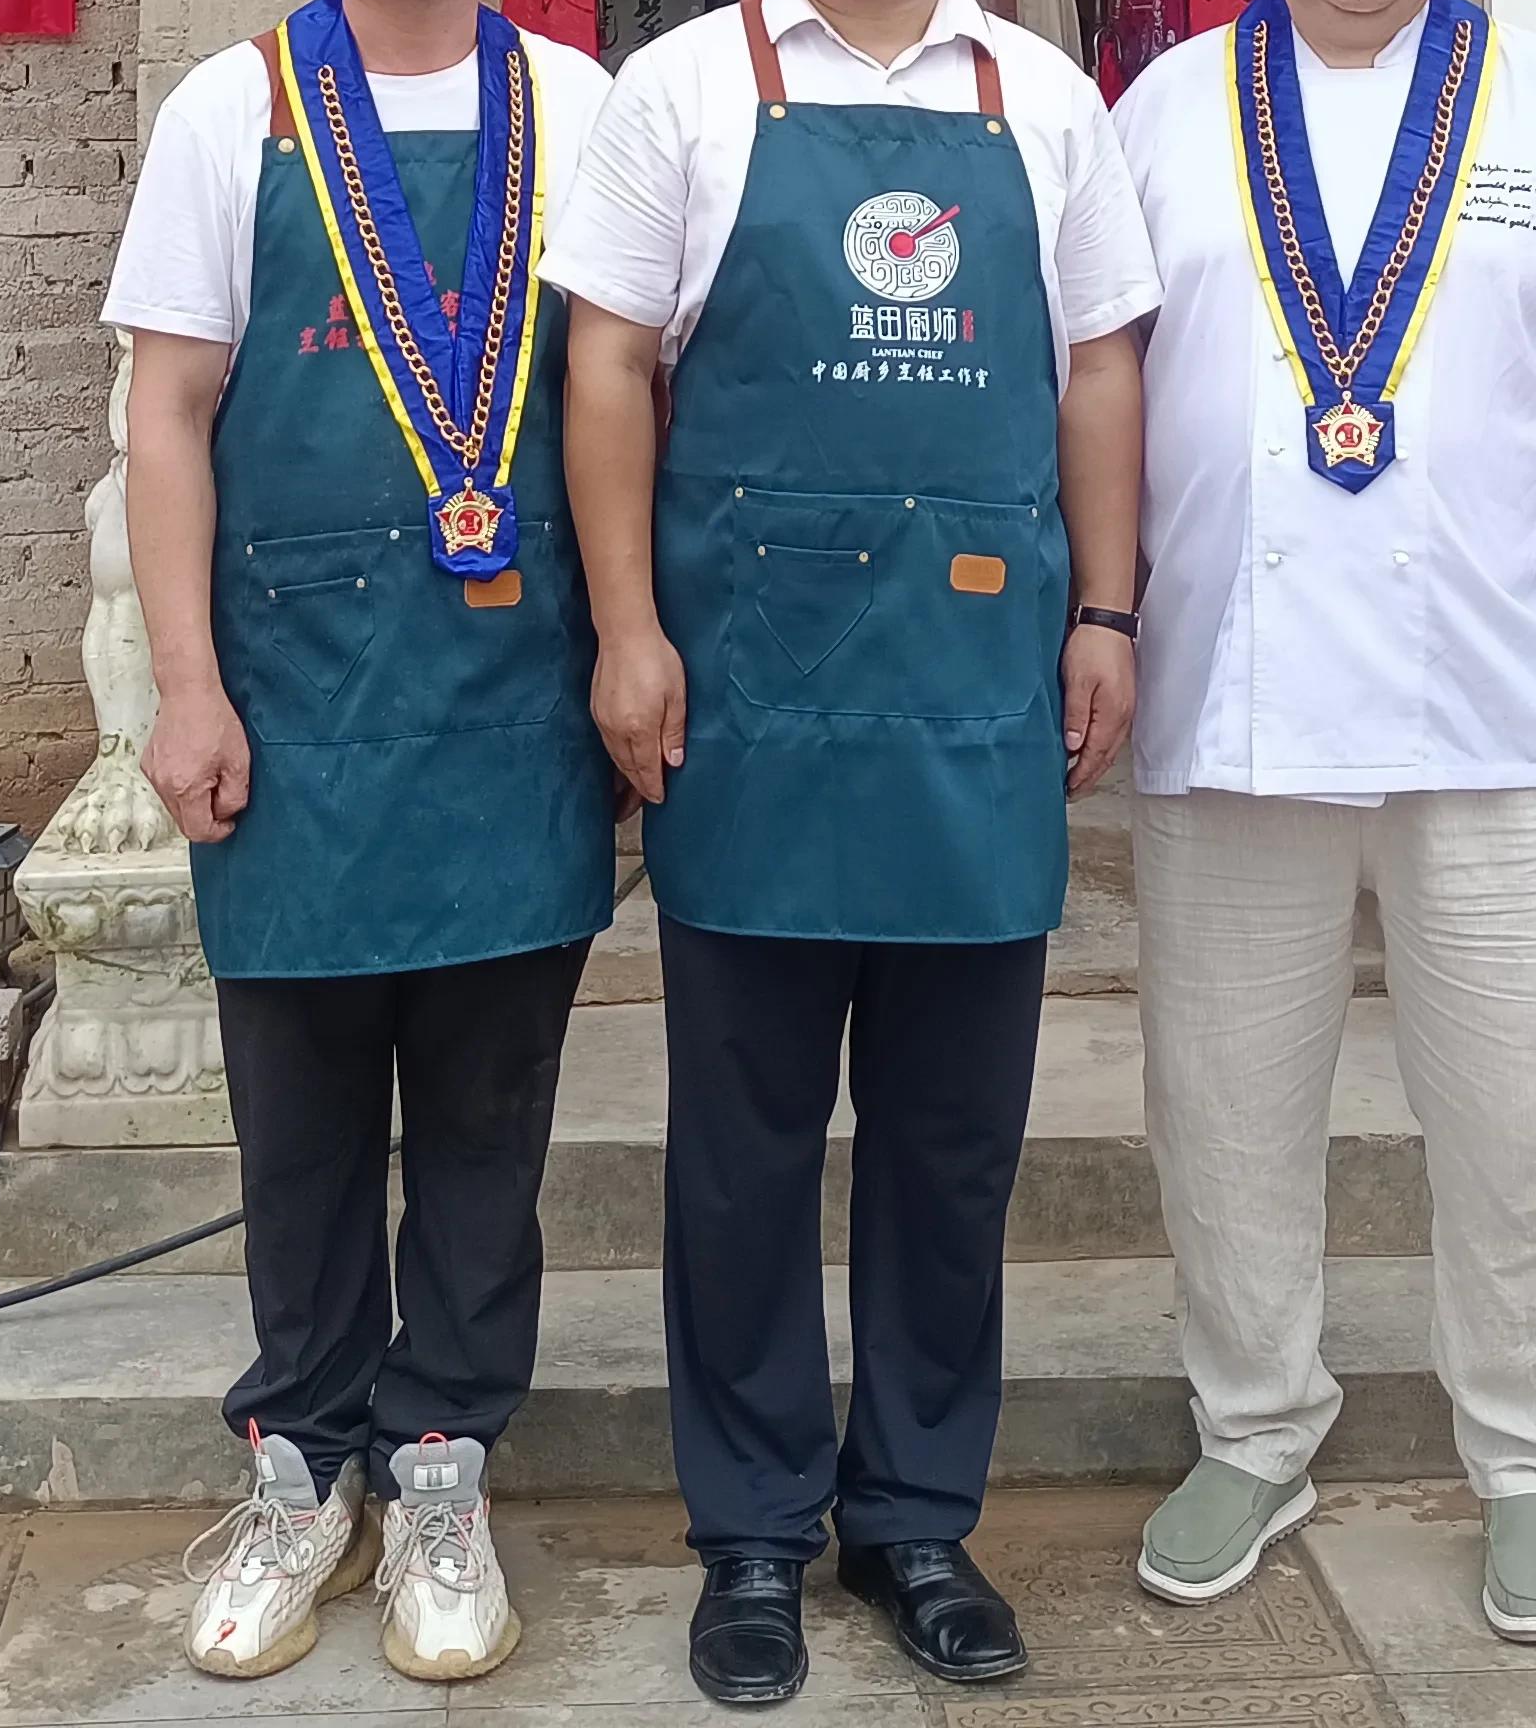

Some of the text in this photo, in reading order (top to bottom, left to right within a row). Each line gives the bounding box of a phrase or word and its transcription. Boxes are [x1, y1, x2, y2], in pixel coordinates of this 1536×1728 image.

[850, 303, 957, 344] 蓝田厨师
[871, 347, 945, 360] LANTIAN CHEF
